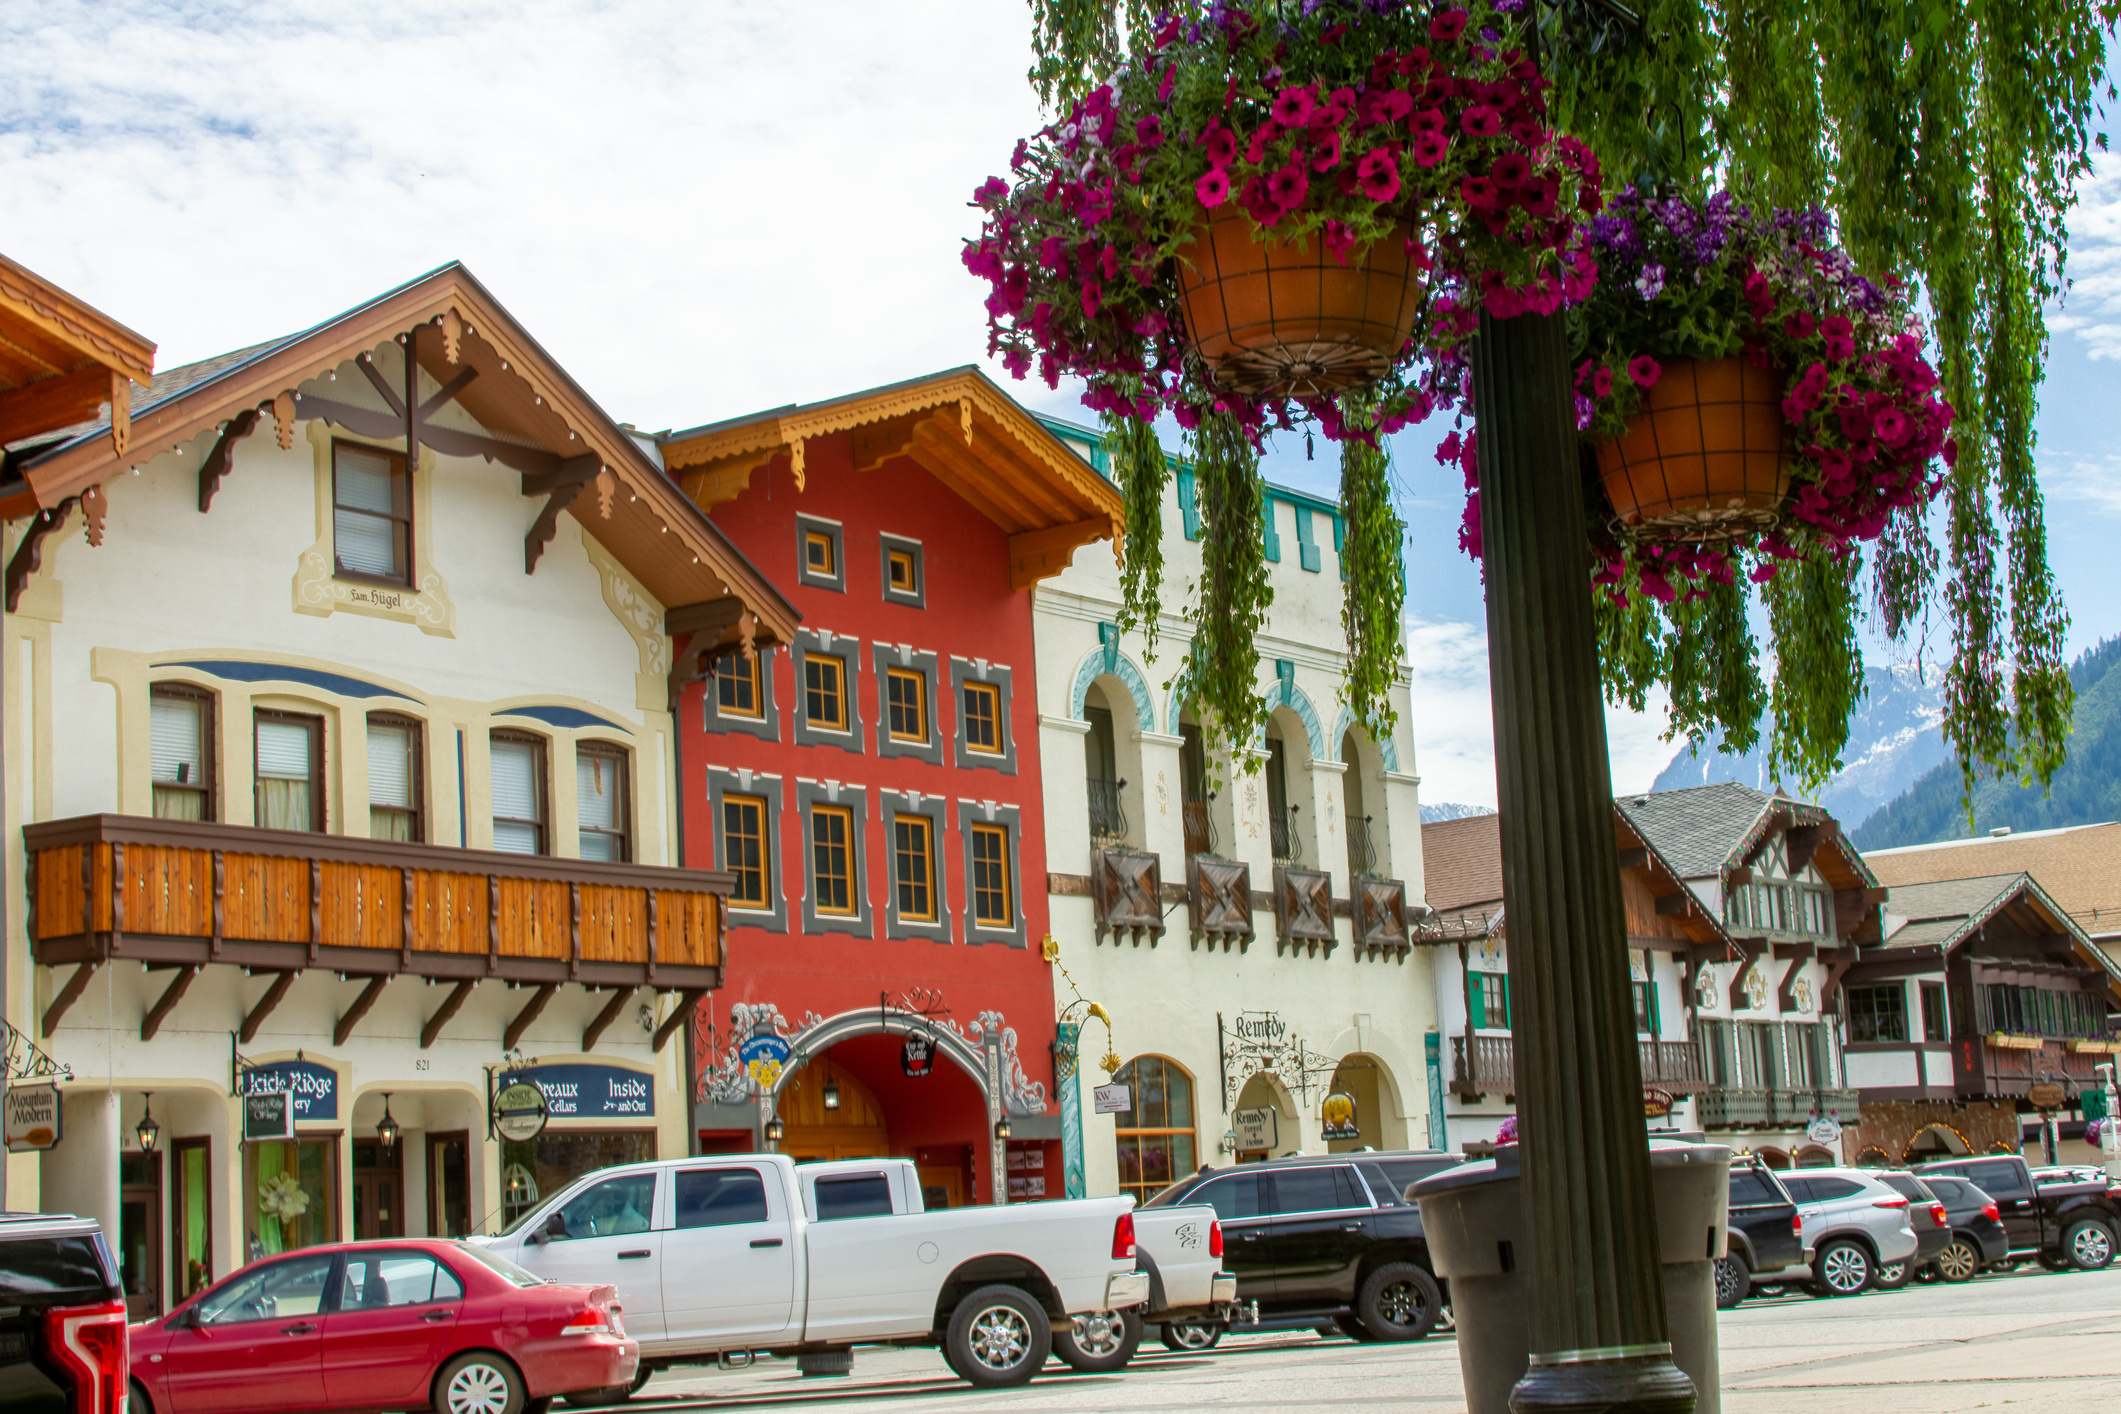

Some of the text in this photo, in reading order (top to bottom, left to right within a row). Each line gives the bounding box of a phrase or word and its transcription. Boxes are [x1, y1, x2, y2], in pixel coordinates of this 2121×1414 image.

[371, 589, 401, 609] Hügel
[1236, 1015, 1286, 1042] Remedy
[416, 1059, 430, 1071] 821
[907, 1050, 927, 1062] Kettle
[250, 1070, 332, 1100] Icicle Ridge
[608, 1077, 647, 1098] Inside
[9, 1090, 53, 1110] Mountain
[507, 1090, 532, 1101] INSIDE
[294, 1098, 311, 1114] ery
[549, 1099, 578, 1113] Cellars
[617, 1100, 647, 1112] and Out
[14, 1106, 53, 1125] Modern
[1236, 1108, 1268, 1126] Remedy
